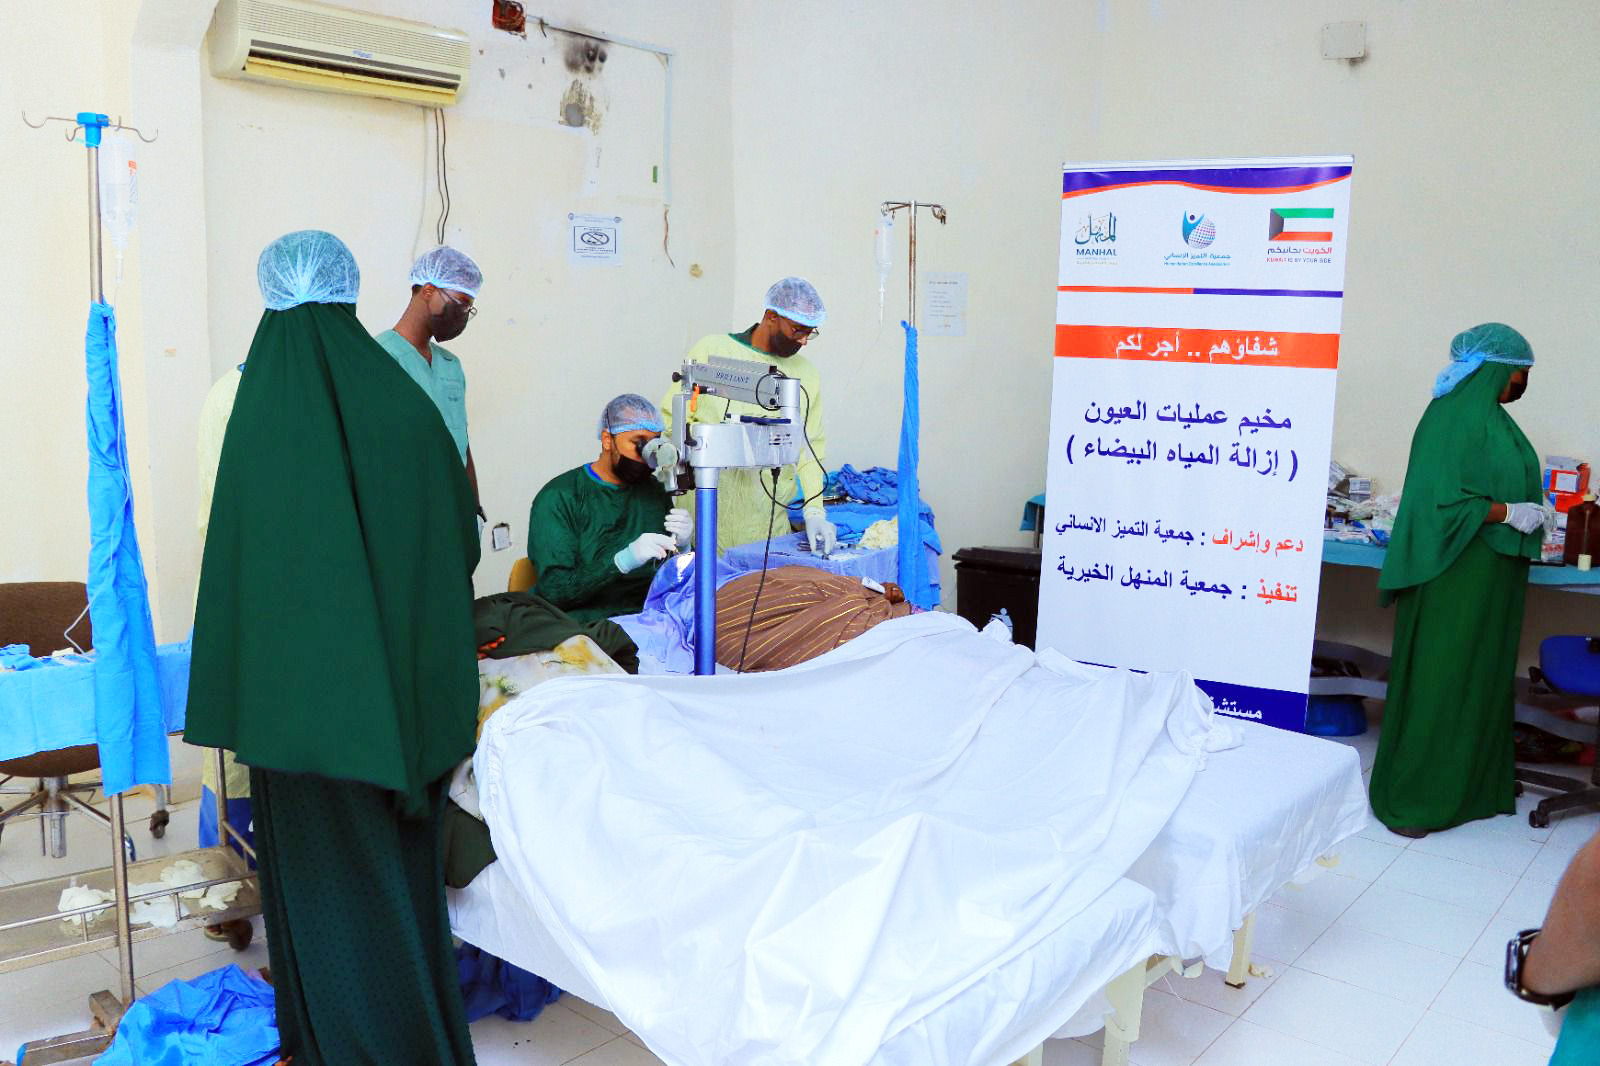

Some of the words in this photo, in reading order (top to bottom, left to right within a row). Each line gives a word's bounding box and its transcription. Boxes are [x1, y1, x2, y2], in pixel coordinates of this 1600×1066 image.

[1076, 248, 1118, 256] MANHAL
[1115, 333, 1142, 360] لكم
[1147, 330, 1180, 358] أجر
[1208, 336, 1279, 363] شفاؤهم
[1084, 399, 1147, 425] العيون
[1156, 402, 1228, 430] عمليات
[1238, 408, 1292, 436] مخيم
[1084, 436, 1157, 465] البيضاء
[1166, 442, 1219, 469] المياه
[1229, 441, 1279, 477] إزالة
[1111, 519, 1149, 539] التميز
[1154, 519, 1195, 546] جمعية
[1211, 528, 1271, 553] وإشراف
[1274, 538, 1304, 557] دعم
[1057, 555, 1114, 582] الخيرية
[1120, 565, 1172, 590] المنهل
[1179, 570, 1232, 599] جمعية
[1256, 578, 1298, 605] تنفيذ
